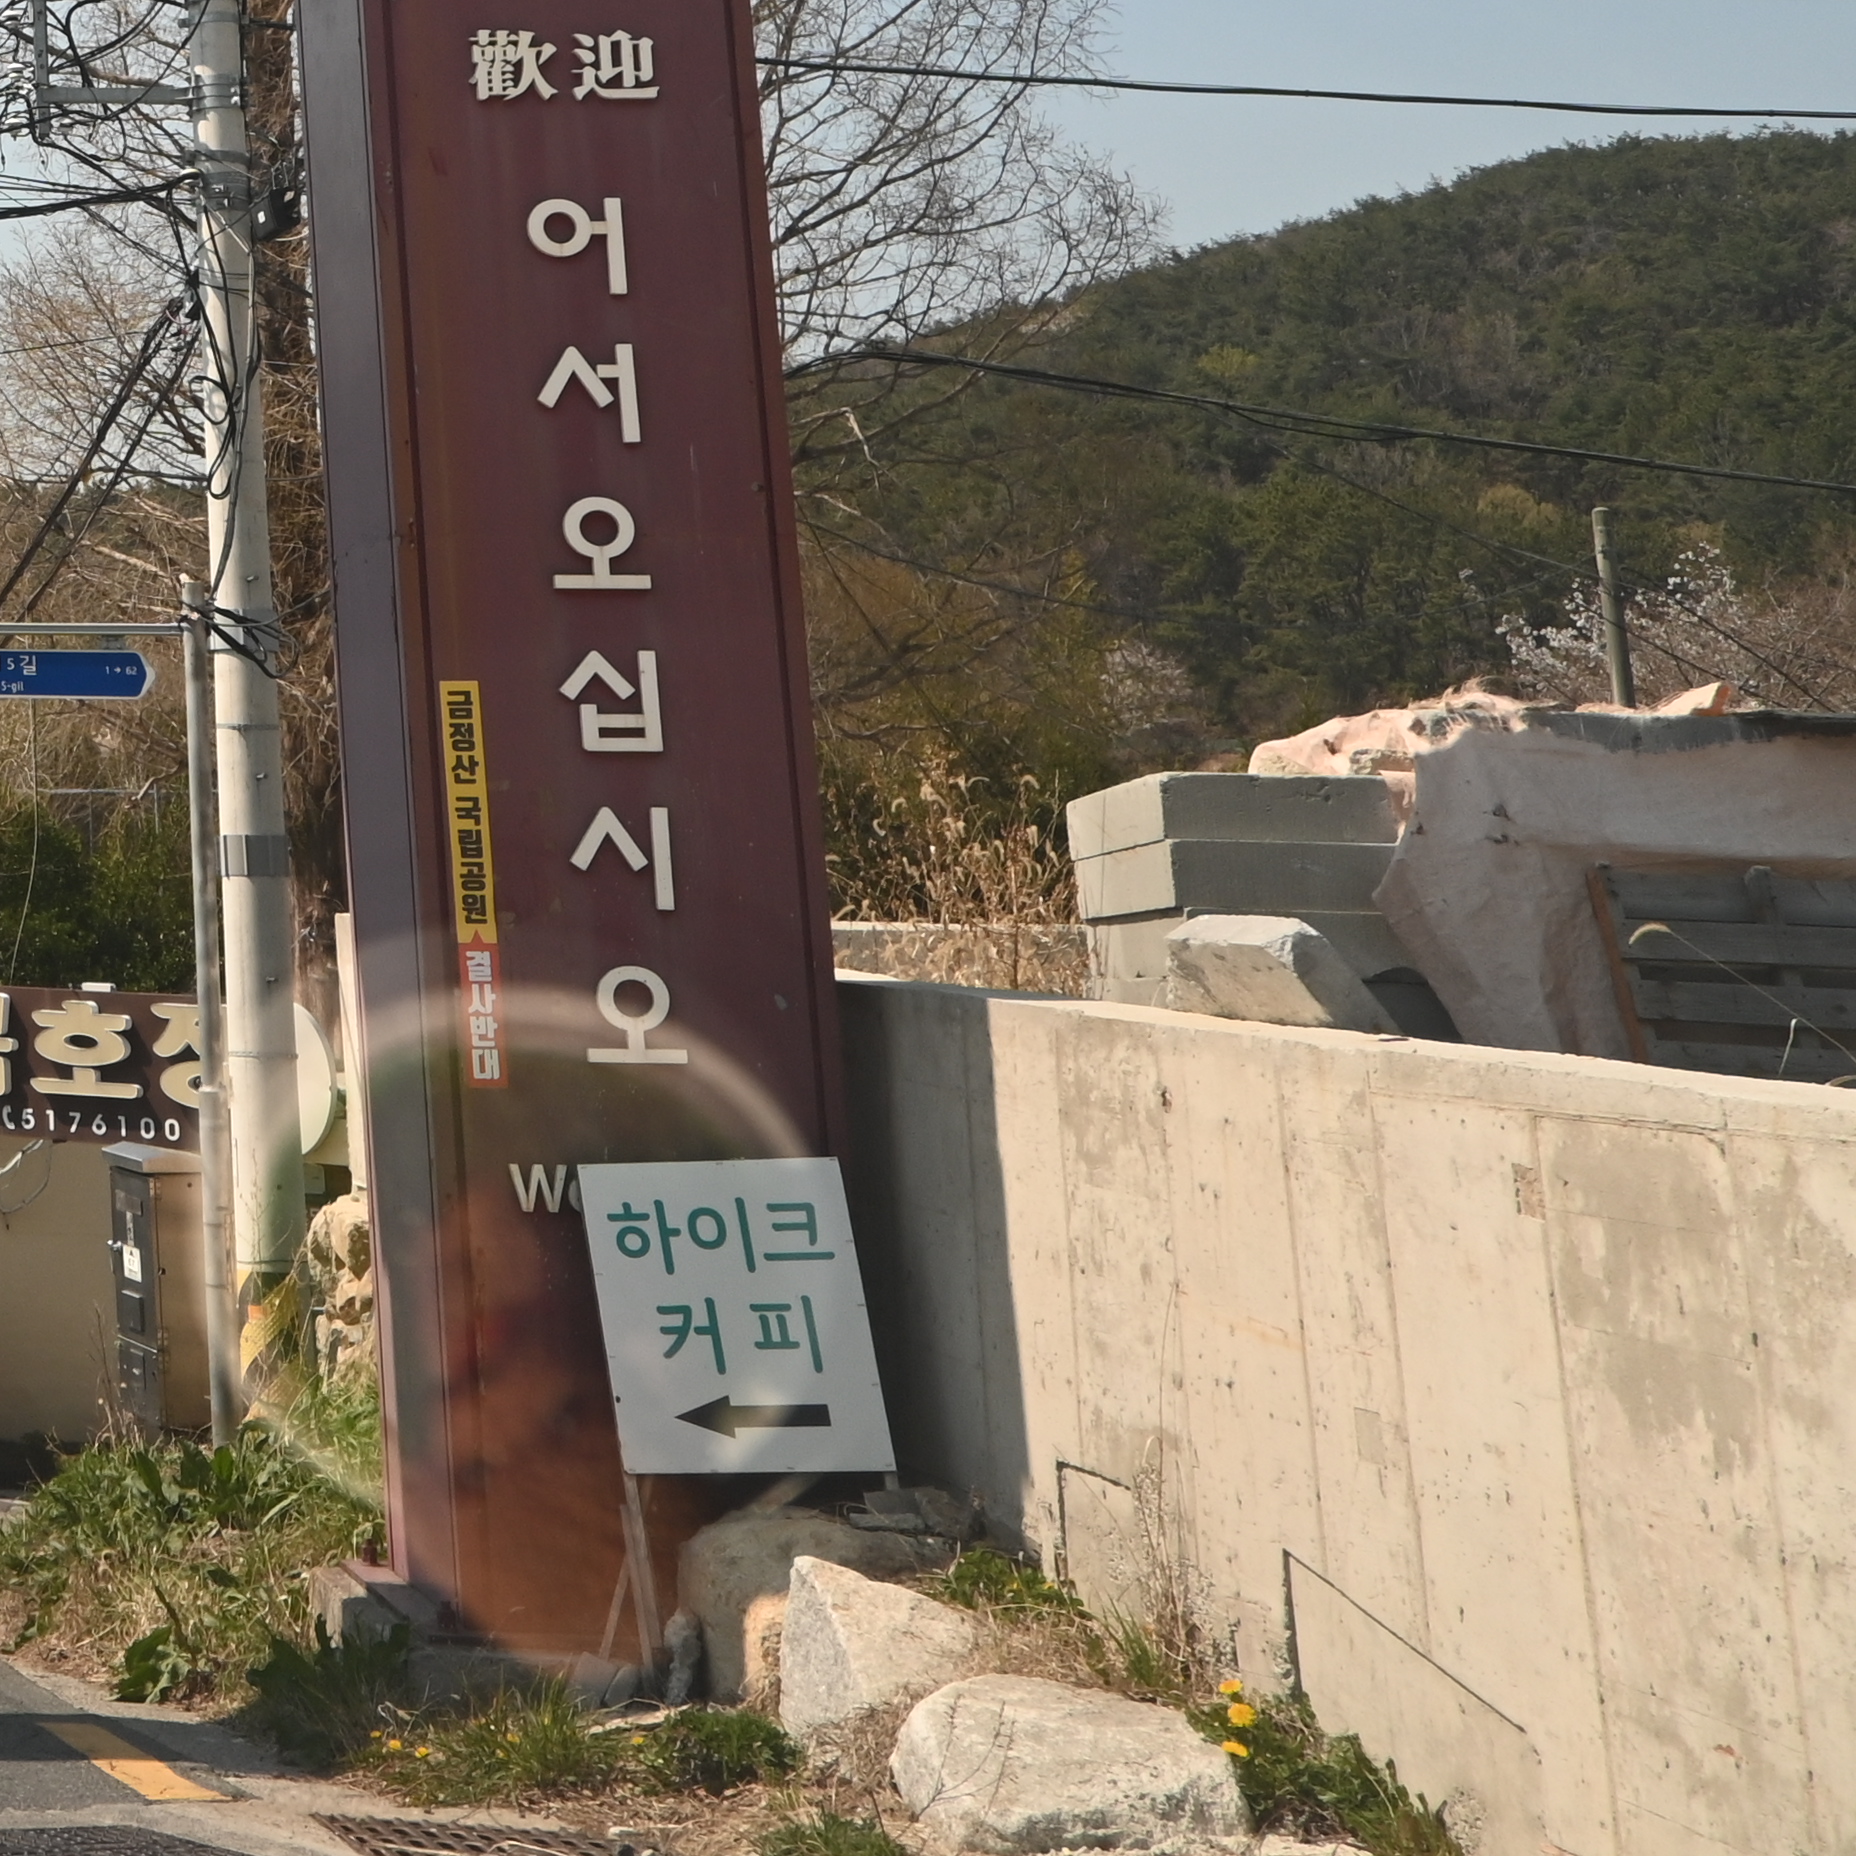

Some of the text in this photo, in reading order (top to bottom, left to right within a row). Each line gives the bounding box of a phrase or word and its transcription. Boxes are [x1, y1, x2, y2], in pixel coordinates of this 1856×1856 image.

[125, 666, 138, 675] 62
[526, 197, 689, 1065] 어서오십시오
[1, 679, 25, 693] 5-gil
[446, 689, 489, 925] 금정산 국립공원
[465, 950, 501, 1082] 결사반대
[20, 1106, 181, 1142] 5176100
[606, 1196, 836, 1276] 하이크
[655, 1293, 825, 1376] 커피
